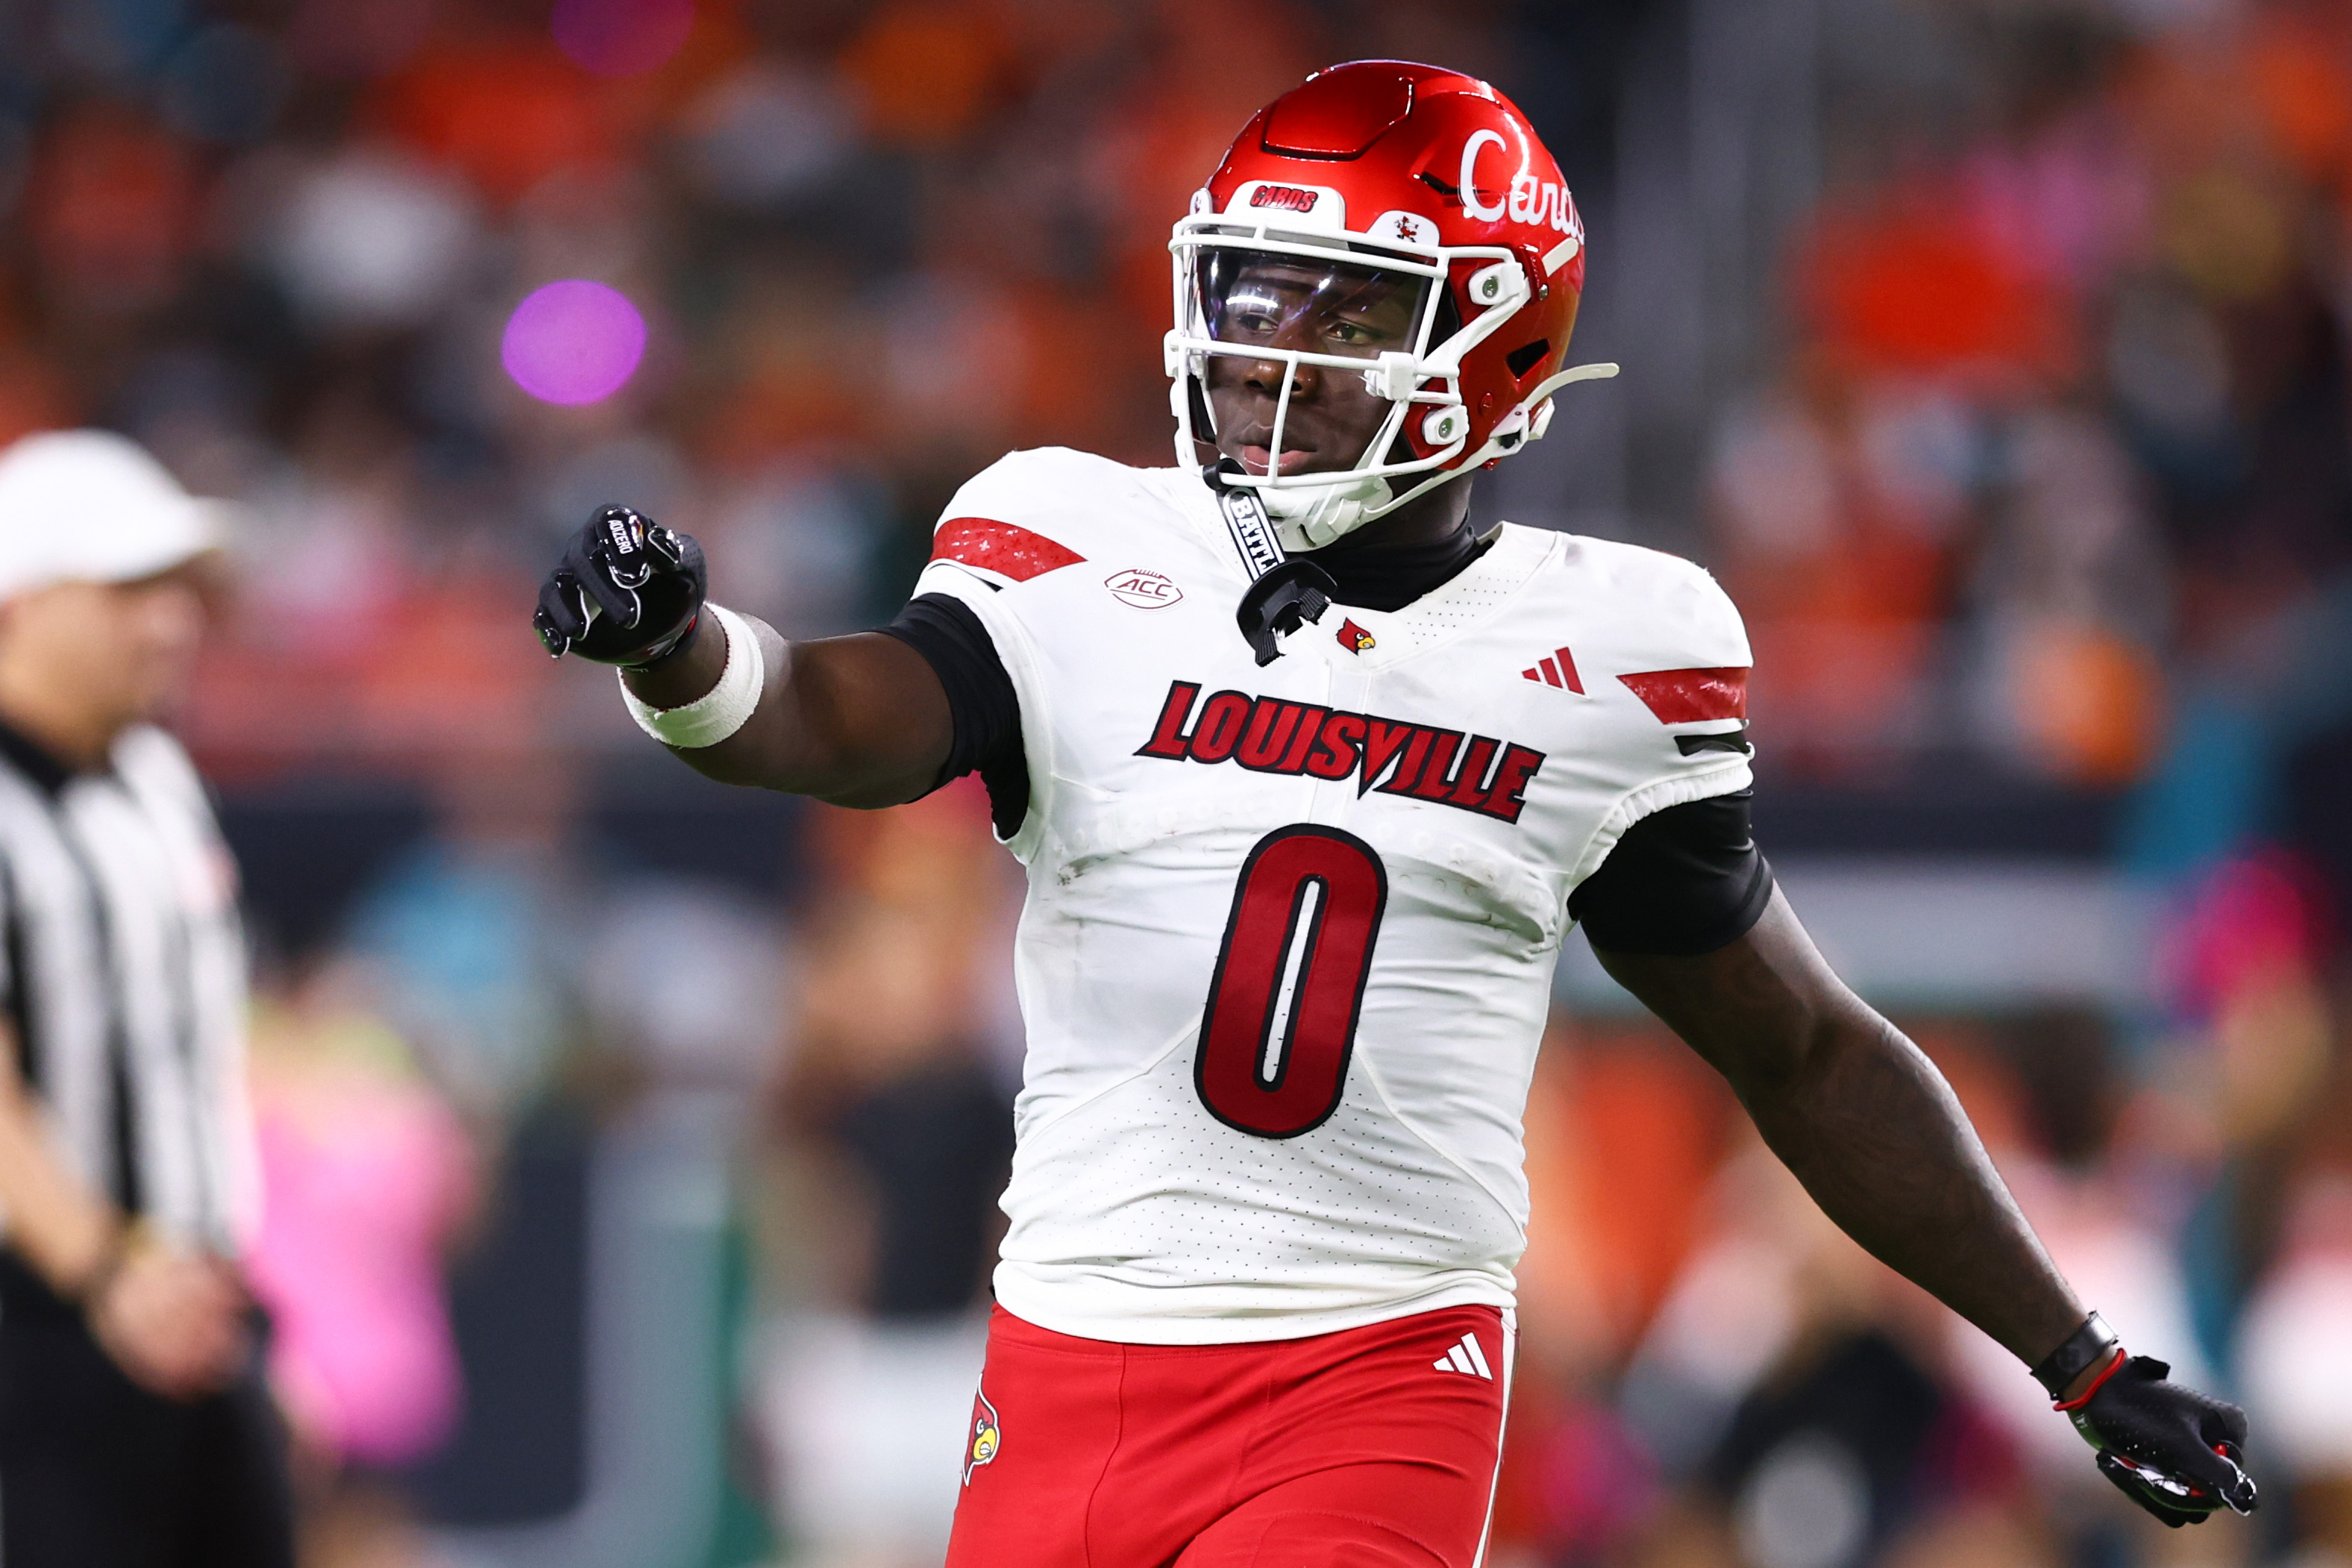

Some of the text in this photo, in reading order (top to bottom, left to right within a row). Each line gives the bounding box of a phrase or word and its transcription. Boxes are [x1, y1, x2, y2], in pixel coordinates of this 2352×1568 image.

[1249, 185, 1318, 213] CARDS
[1231, 495, 1279, 575] BATTL
[1116, 579, 1173, 597] ACC
[1132, 680, 1547, 825] LOUISVILLE
[1194, 823, 1388, 1140] 0
